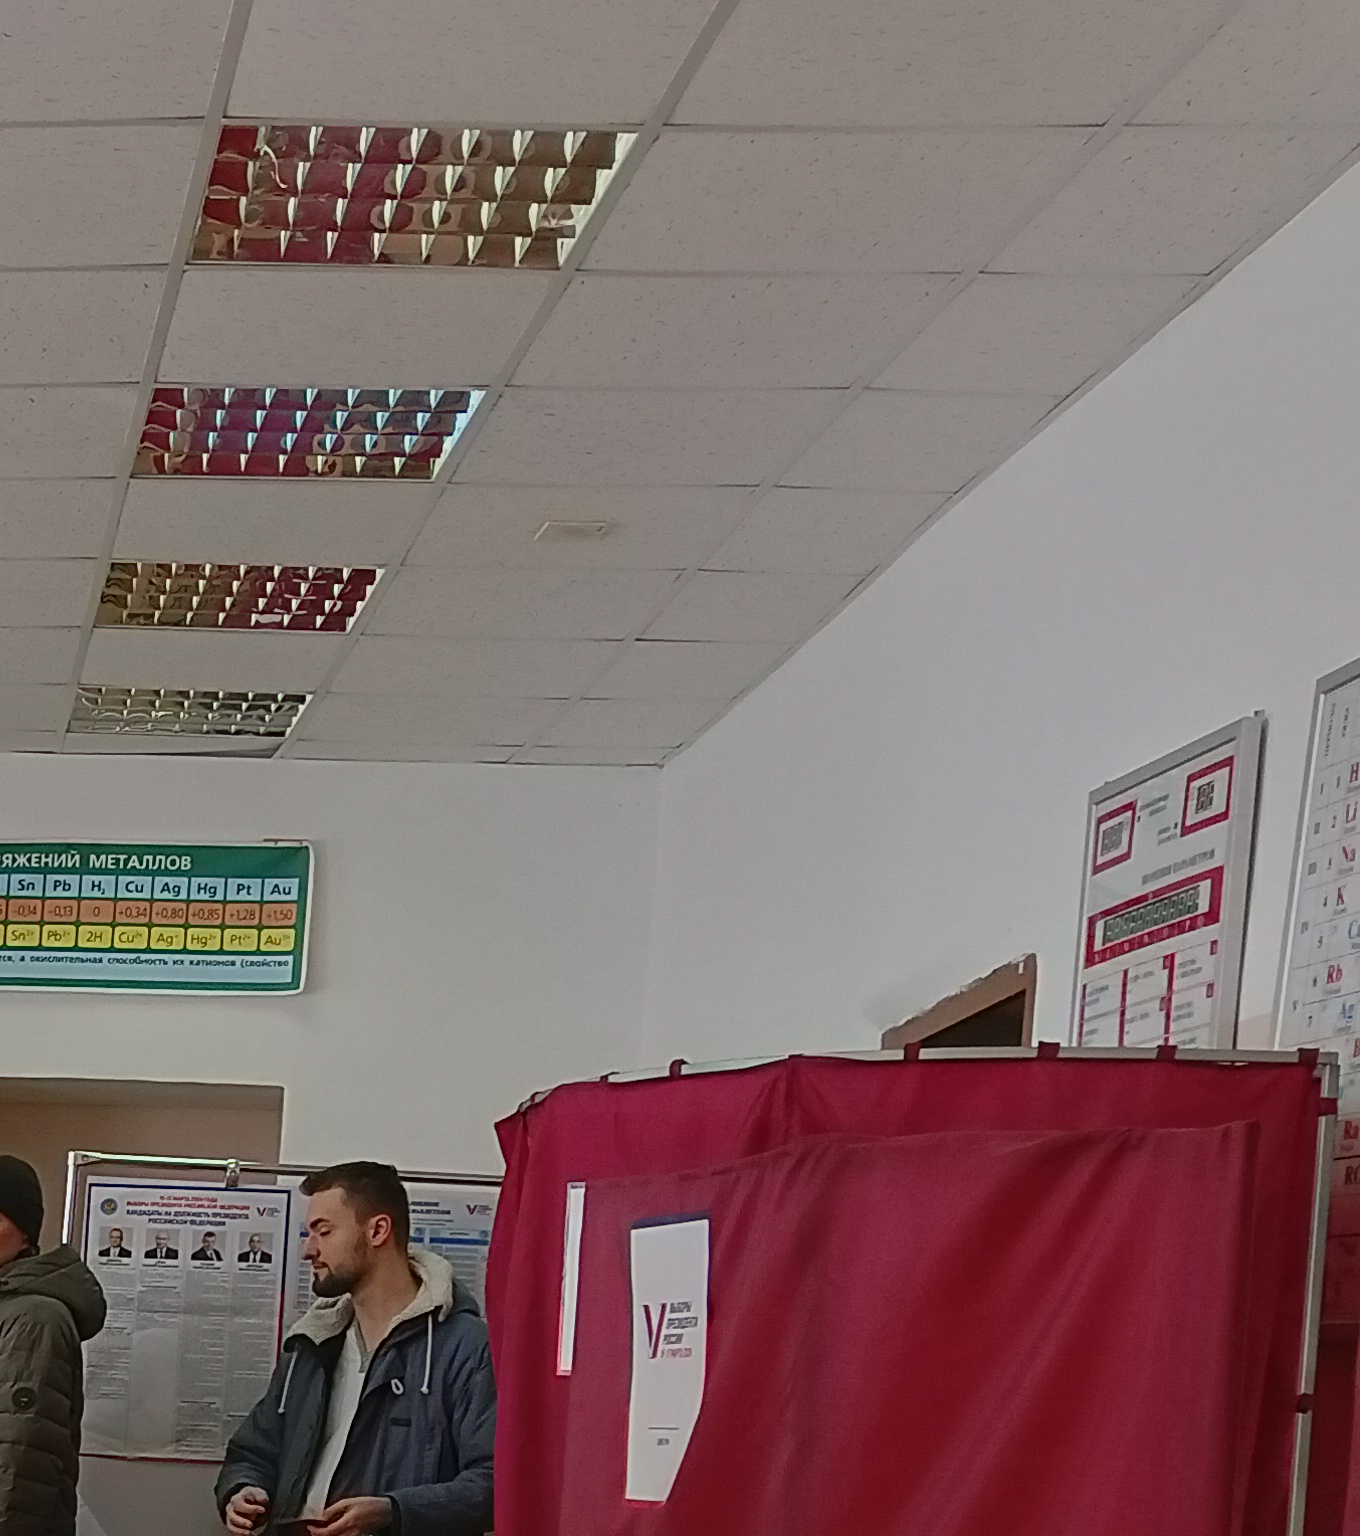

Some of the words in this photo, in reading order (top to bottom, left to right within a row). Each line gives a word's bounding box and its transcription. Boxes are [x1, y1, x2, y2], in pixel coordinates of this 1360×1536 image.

[1349, 762, 1359, 783] H
[89, 854, 192, 871] МЕТАЛЛОВ
[17, 879, 35, 892] Sn
[53, 880, 72, 892] Pb
[125, 881, 144, 893] Cu
[160, 882, 182, 897] Ag
[197, 883, 218, 898] Hg
[236, 883, 253, 896] Pt
[270, 883, 292, 896] Au
[92, 906, 101, 917] 0
[1327, 964, 1343, 984] Rb
